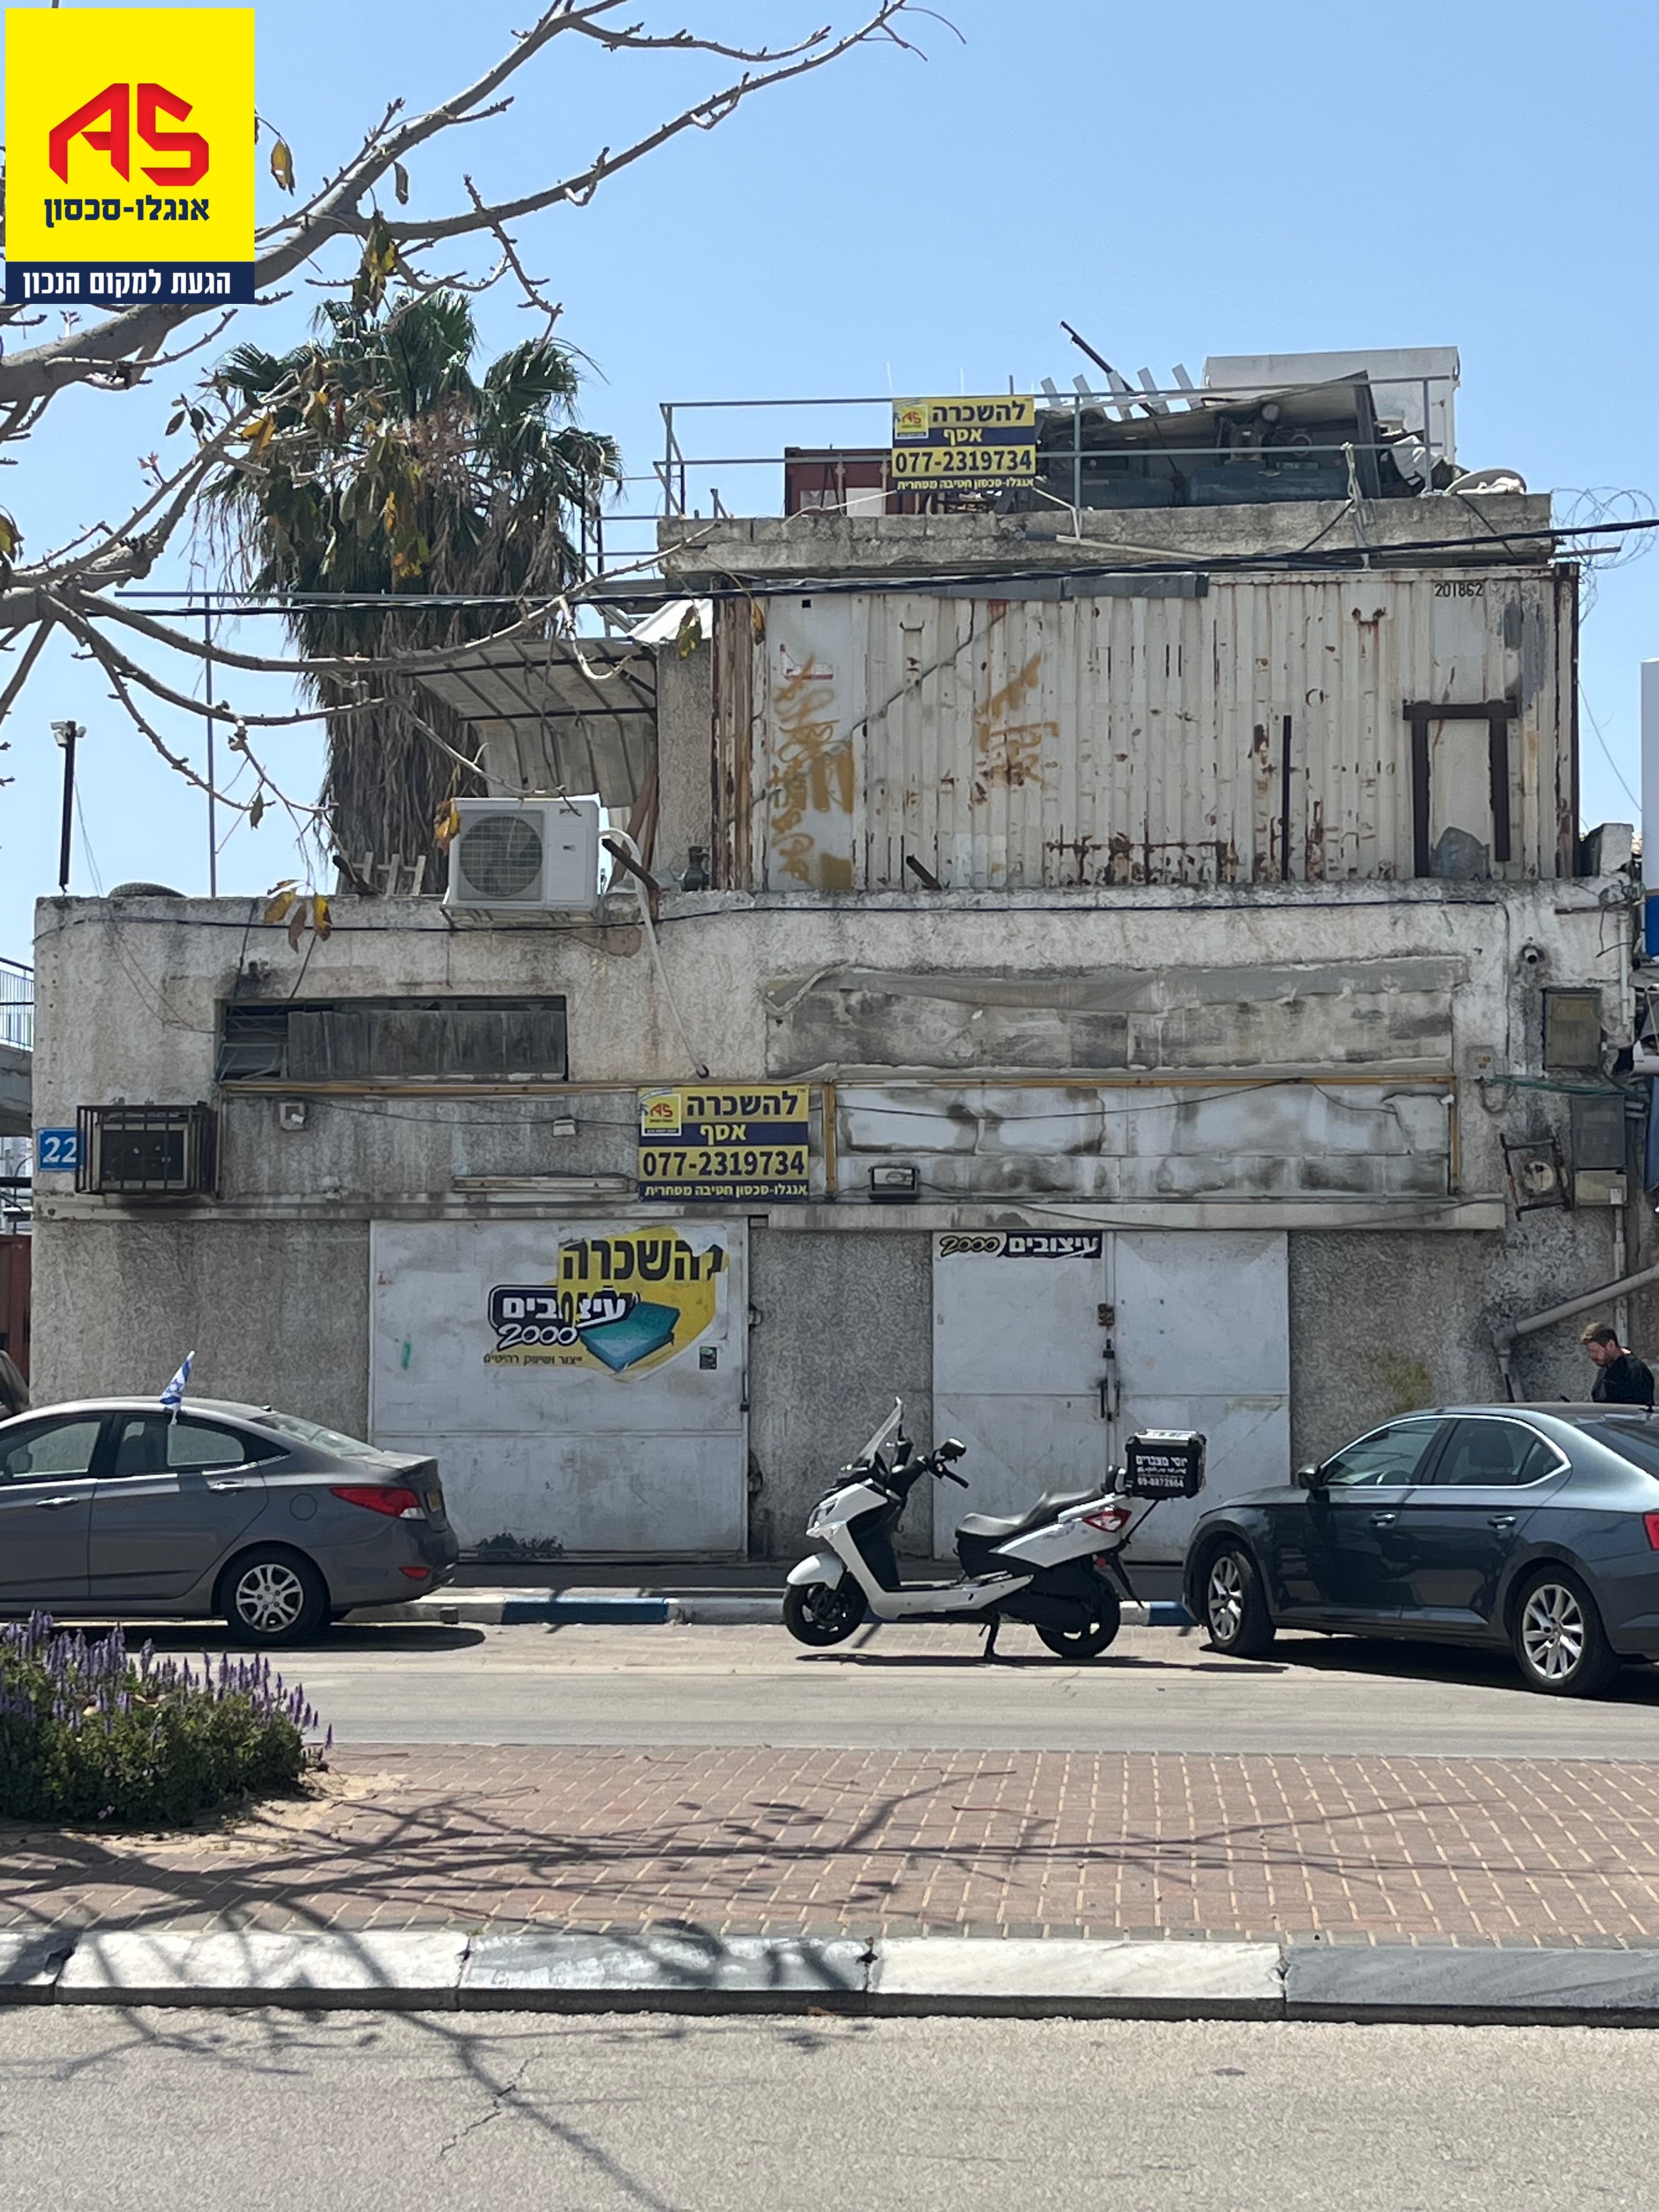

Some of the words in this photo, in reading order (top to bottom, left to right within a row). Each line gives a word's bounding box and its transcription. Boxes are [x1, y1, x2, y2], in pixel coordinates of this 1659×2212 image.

[902, 411, 922, 424] AS
[933, 400, 1025, 422] להשכרה
[943, 428, 983, 446] אסף
[895, 450, 1032, 473] 077-2319734
[898, 480, 938, 490] מסחרית
[939, 479, 973, 489] חטיבה
[974, 477, 1034, 490] אנגלו-סכסון
[1434, 582, 1483, 597] 201862
[650, 1103, 673, 1118] AS
[687, 1091, 798, 1116] להשכרה
[700, 1124, 747, 1146] אסף
[43, 1137, 77, 1163] 22
[643, 1150, 805, 1177] 077-2319734
[645, 1185, 692, 1196] מסחרית
[695, 1184, 733, 1195] חטיבה
[736, 1183, 809, 1198] אנגלו-סכסון
[939, 1235, 1001, 1258] 2000
[1009, 1237, 1099, 1257] עיצובים
[502, 1297, 627, 1328] עיצבים
[497, 1323, 578, 1350] 2000
